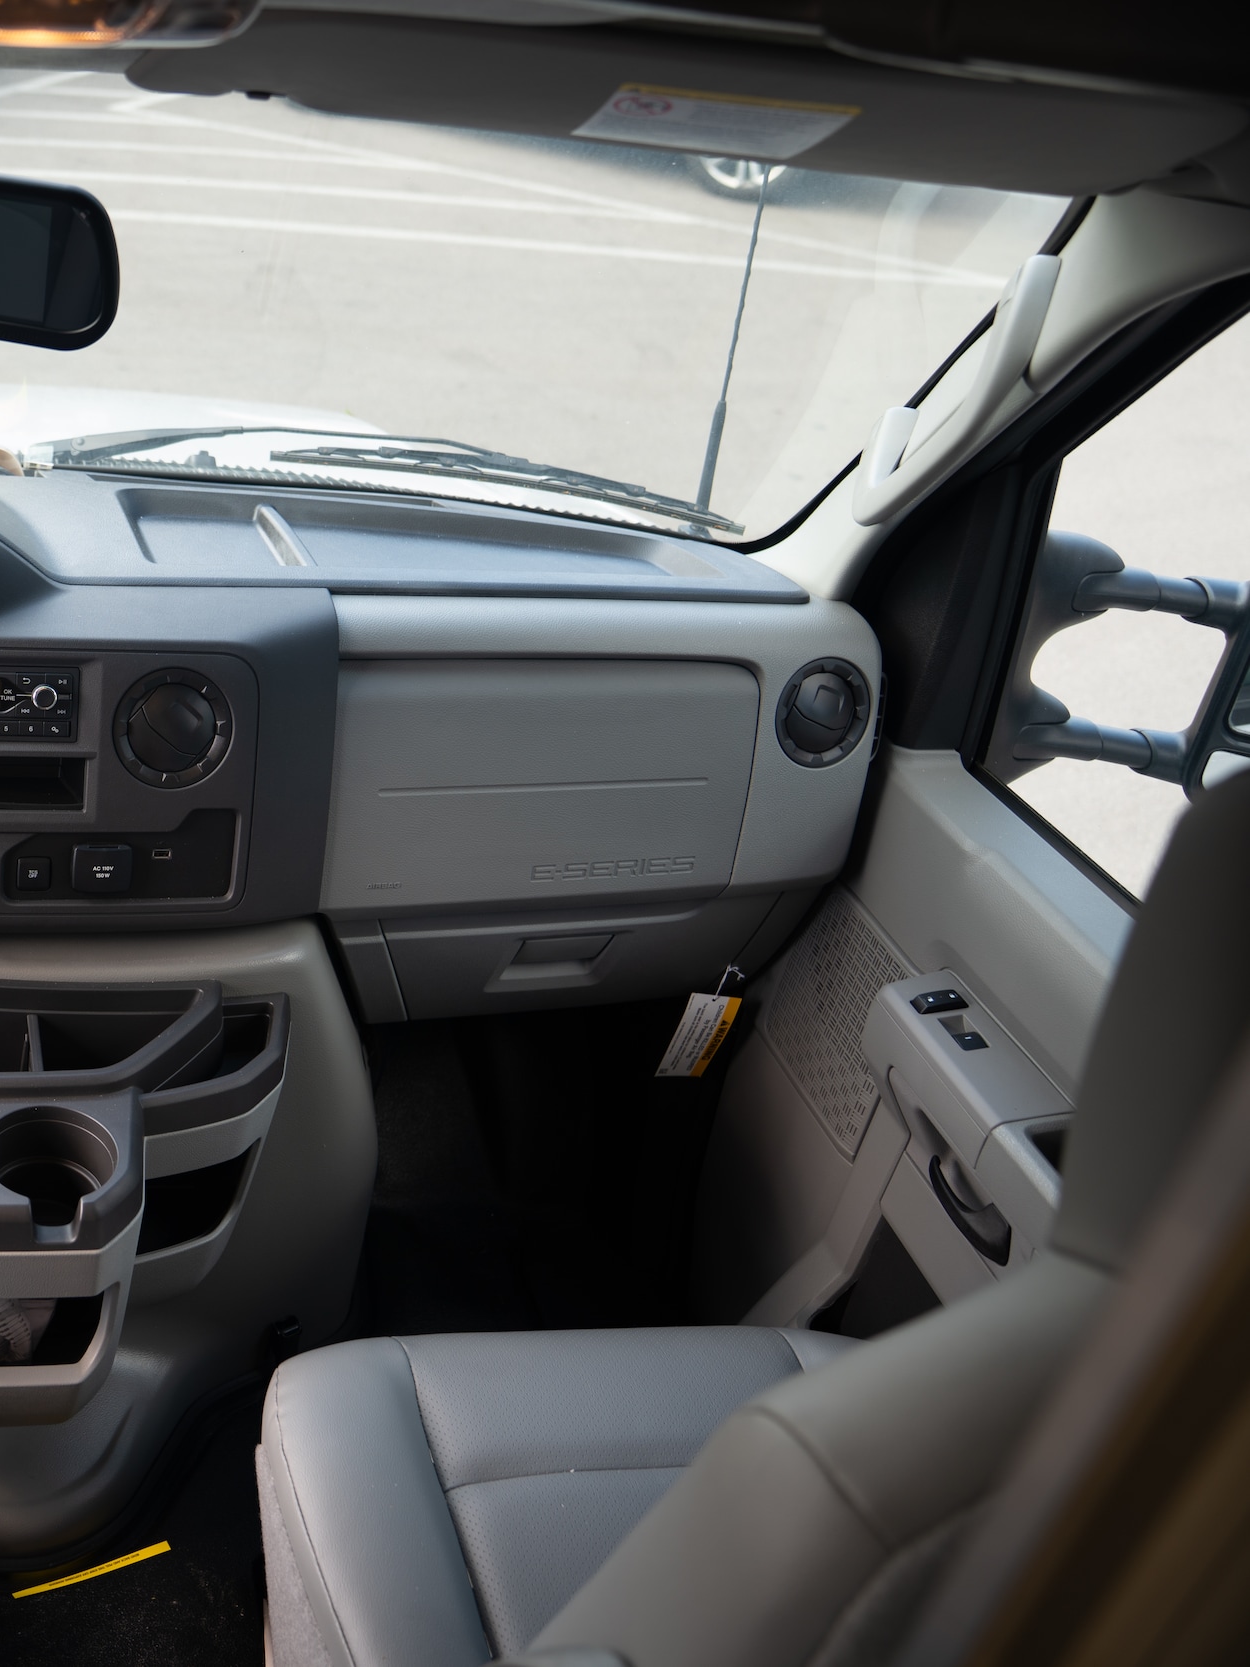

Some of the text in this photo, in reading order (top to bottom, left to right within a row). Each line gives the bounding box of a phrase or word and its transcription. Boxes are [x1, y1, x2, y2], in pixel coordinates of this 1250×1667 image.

[3, 724, 9, 732] 5
[530, 855, 696, 883] E-SERIES
[366, 881, 401, 890] AIRBAG
[713, 1004, 725, 1022] Children
[701, 1027, 726, 1060] WARNING
